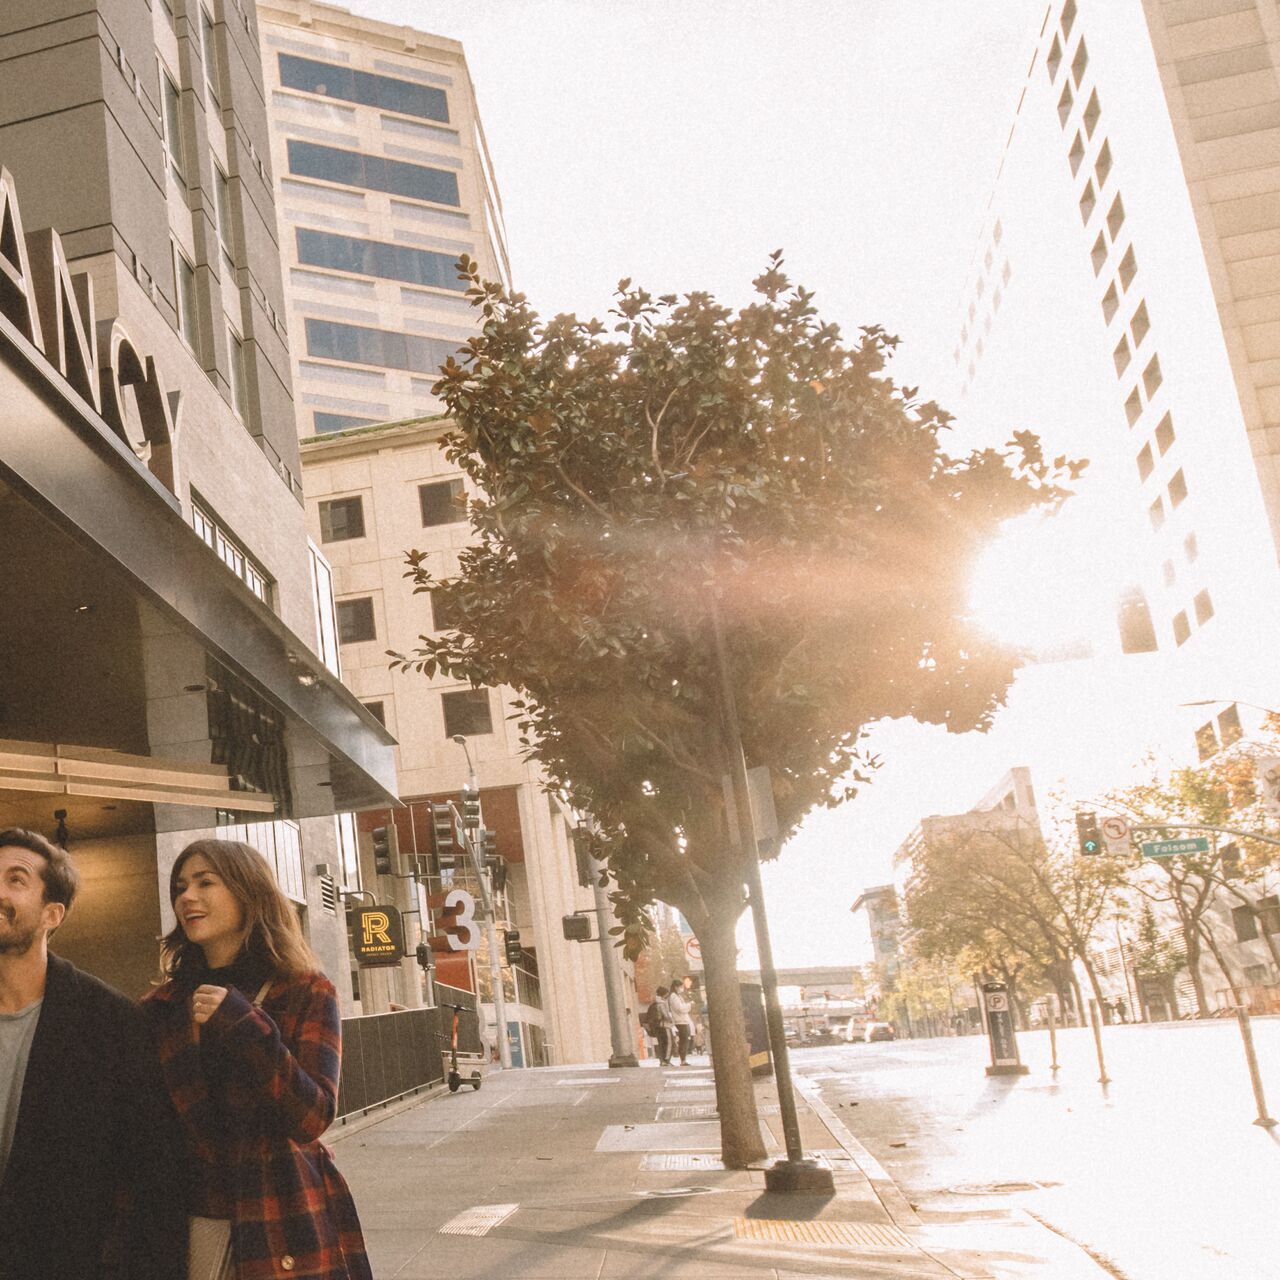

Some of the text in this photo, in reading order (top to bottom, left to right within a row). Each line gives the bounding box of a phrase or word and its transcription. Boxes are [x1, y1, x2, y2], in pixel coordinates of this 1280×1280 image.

[1153, 842, 1197, 853] Folsom
[362, 912, 391, 944] R
[445, 889, 481, 951] 3
[361, 945, 396, 953] RADIATOR
